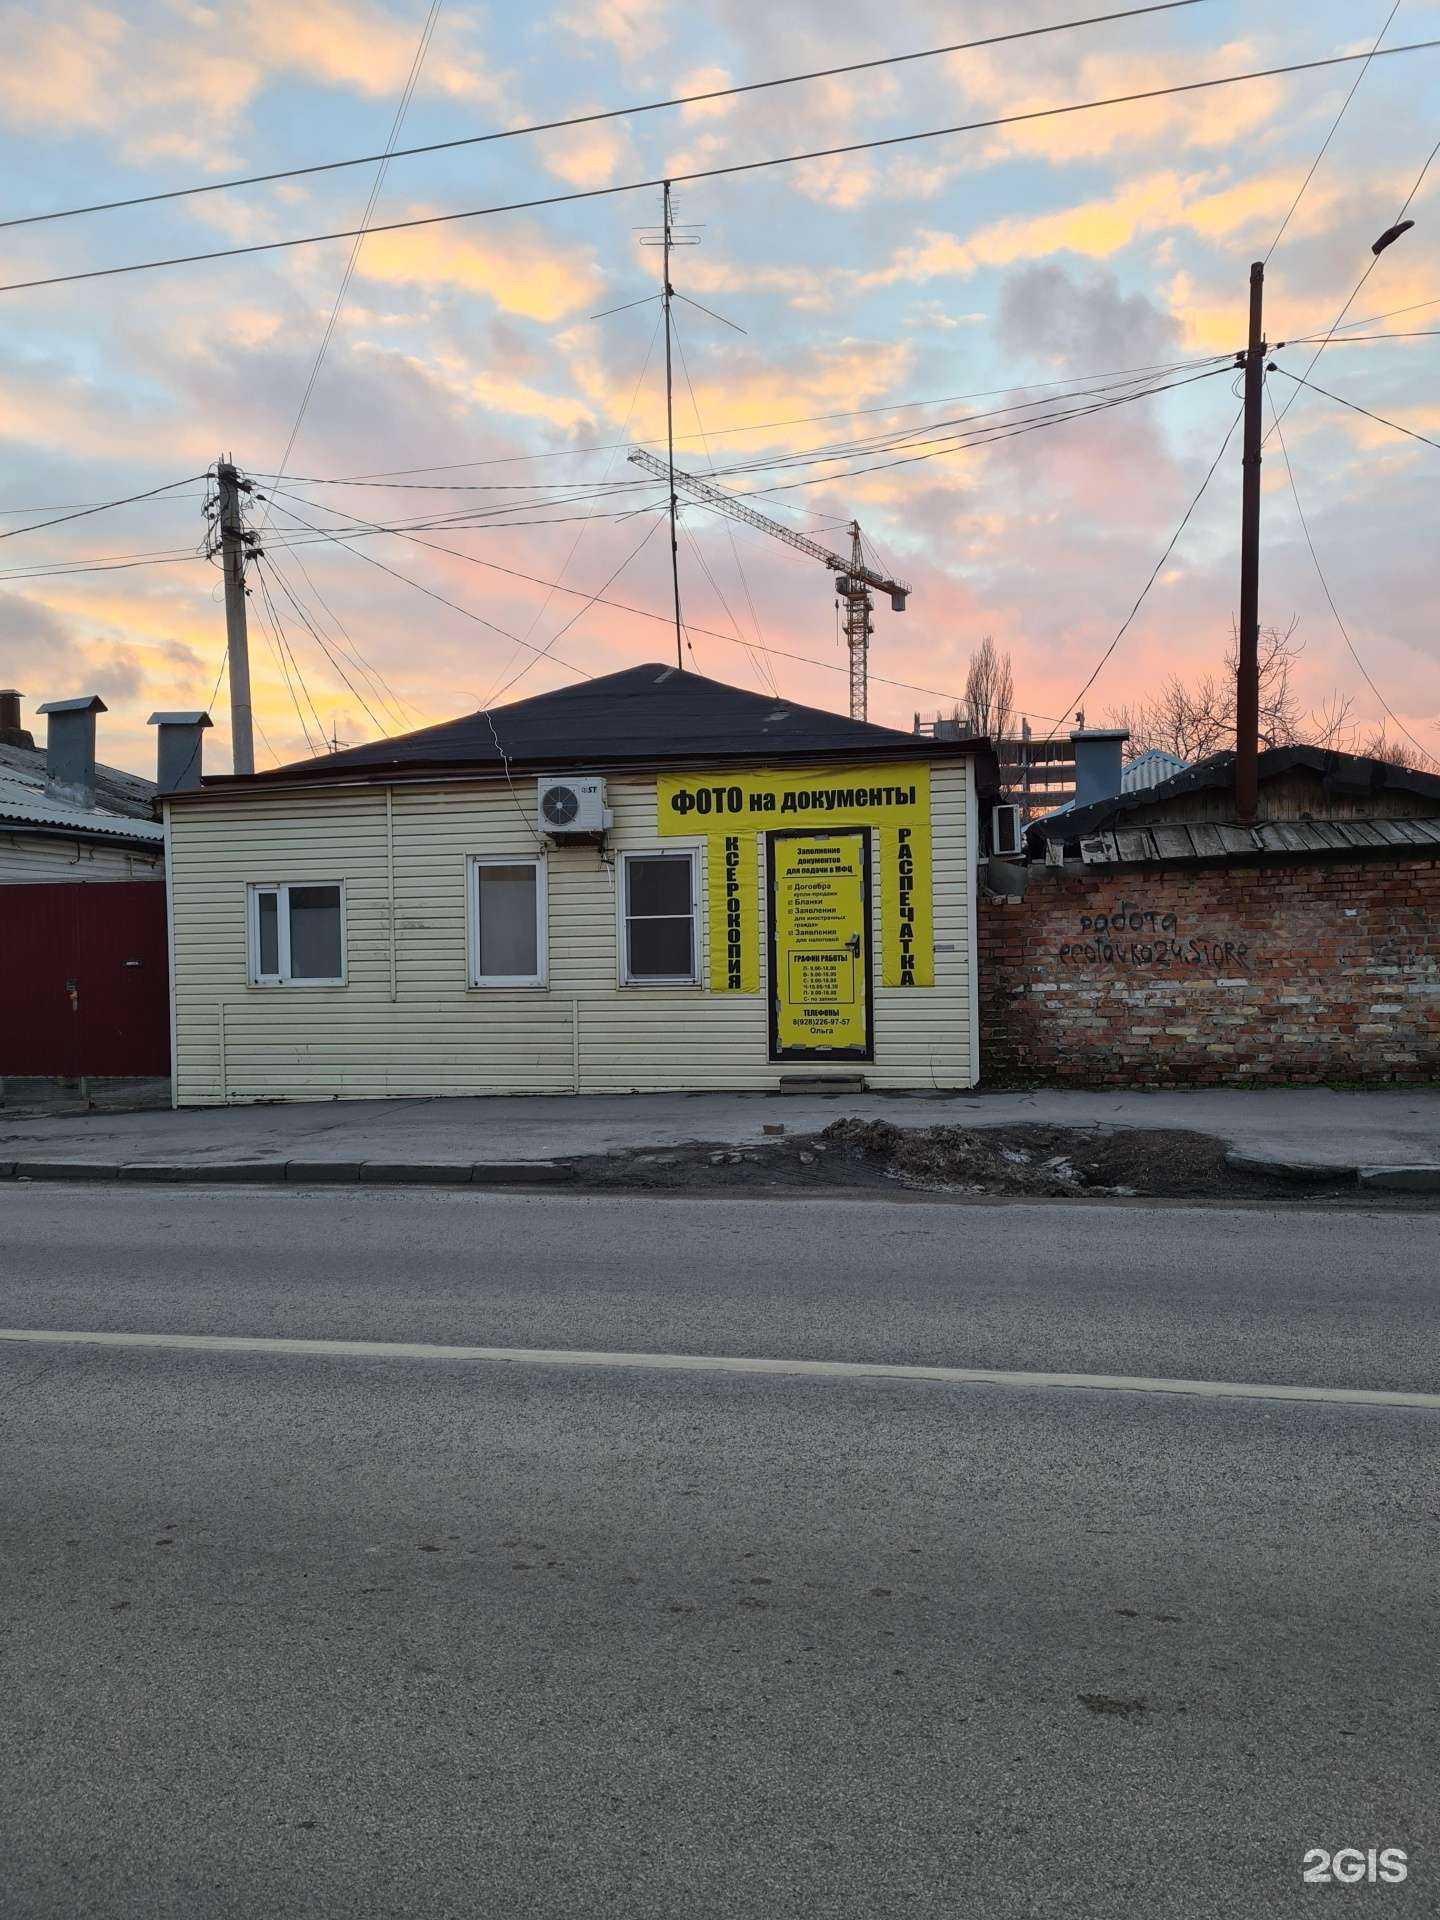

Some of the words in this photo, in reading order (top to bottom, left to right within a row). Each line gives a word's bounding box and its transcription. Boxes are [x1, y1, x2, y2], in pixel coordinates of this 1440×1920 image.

[671, 786, 743, 815] ФОТО
[749, 793, 776, 812] на
[780, 785, 916, 814] документы
[797, 847, 841, 855] Заполнение
[797, 857, 841, 865] документов
[786, 867, 800, 875] для
[801, 866, 829, 875] подачи
[835, 865, 853, 873] МФЦ
[898, 828, 915, 985] РАСПЕЧАТКА
[725, 836, 741, 989] КСЕРОКОПИЯ
[821, 954, 848, 962] РАБОТЫ
[793, 1018, 850, 1026] 8(928)226-97-57
[810, 1027, 834, 1035] Ольга
